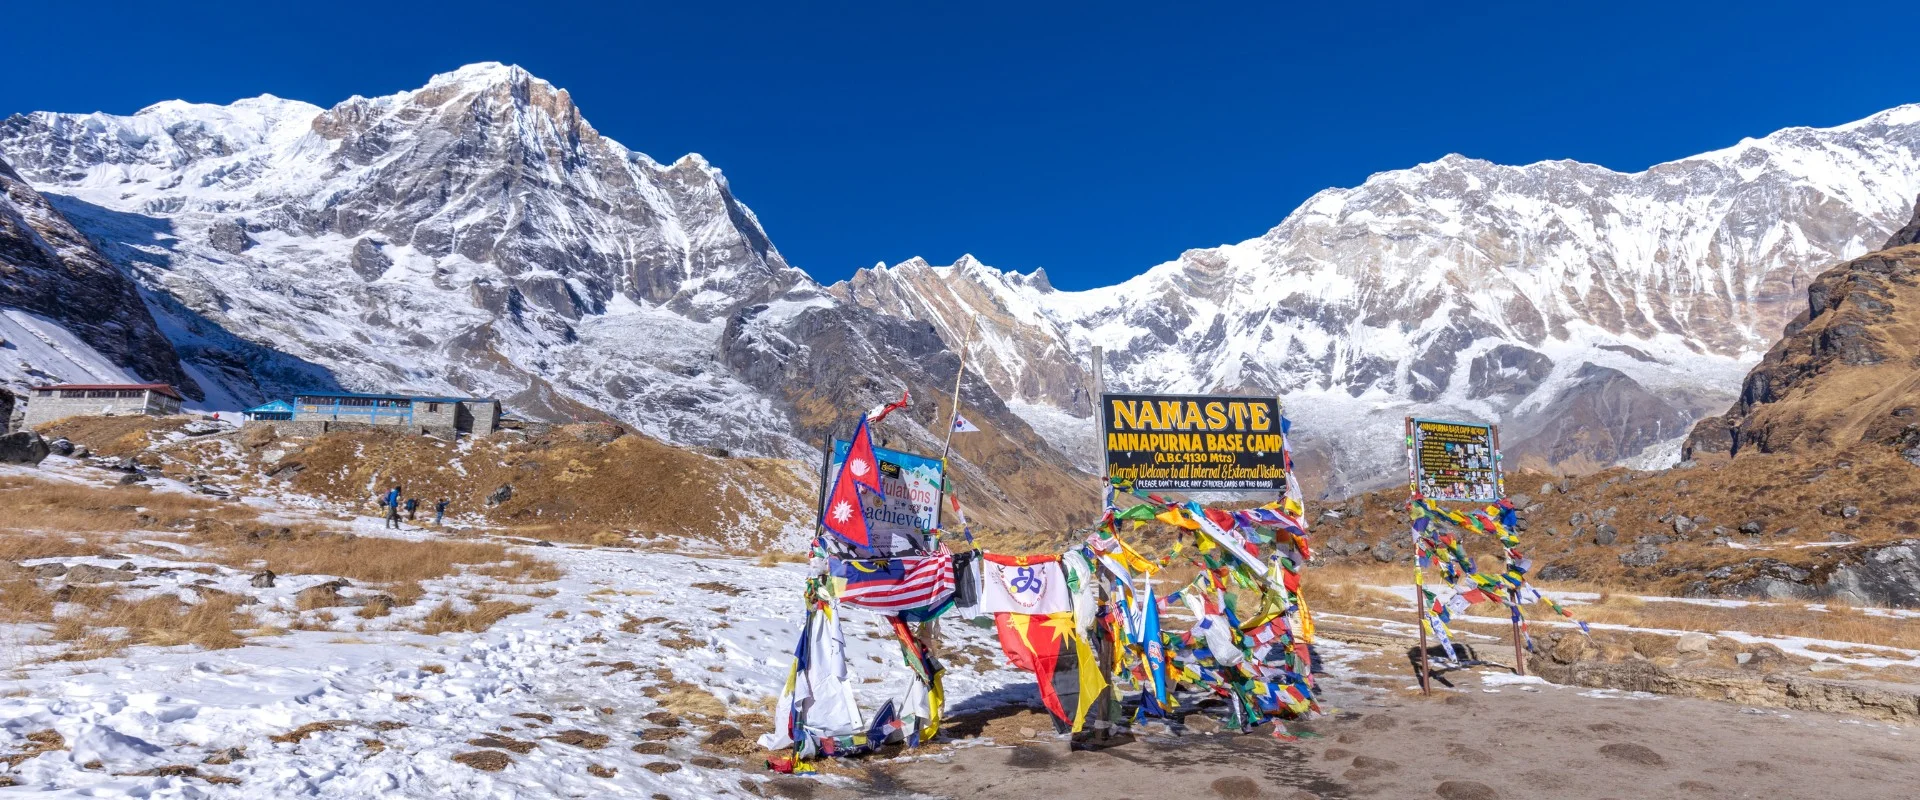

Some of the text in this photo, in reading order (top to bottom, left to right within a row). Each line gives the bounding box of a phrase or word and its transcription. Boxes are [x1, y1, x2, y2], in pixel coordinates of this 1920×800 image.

[1112, 400, 1271, 431] NAMASTE
[1108, 433, 1283, 453] ANNAPURNA BASE CAMP
[1209, 453, 1236, 464] Mtrs)
[1109, 462, 1139, 482] Warmly
[1140, 463, 1170, 480] Welcome
[1171, 464, 1178, 478] to
[1179, 464, 1190, 479] all
[1190, 464, 1221, 479] Internal
[1260, 464, 1286, 479] Visitors
[882, 479, 931, 504] tulations
[1174, 480, 1190, 489] PLACE
[1191, 480, 1201, 488] ANY
[866, 505, 932, 530] achieved
